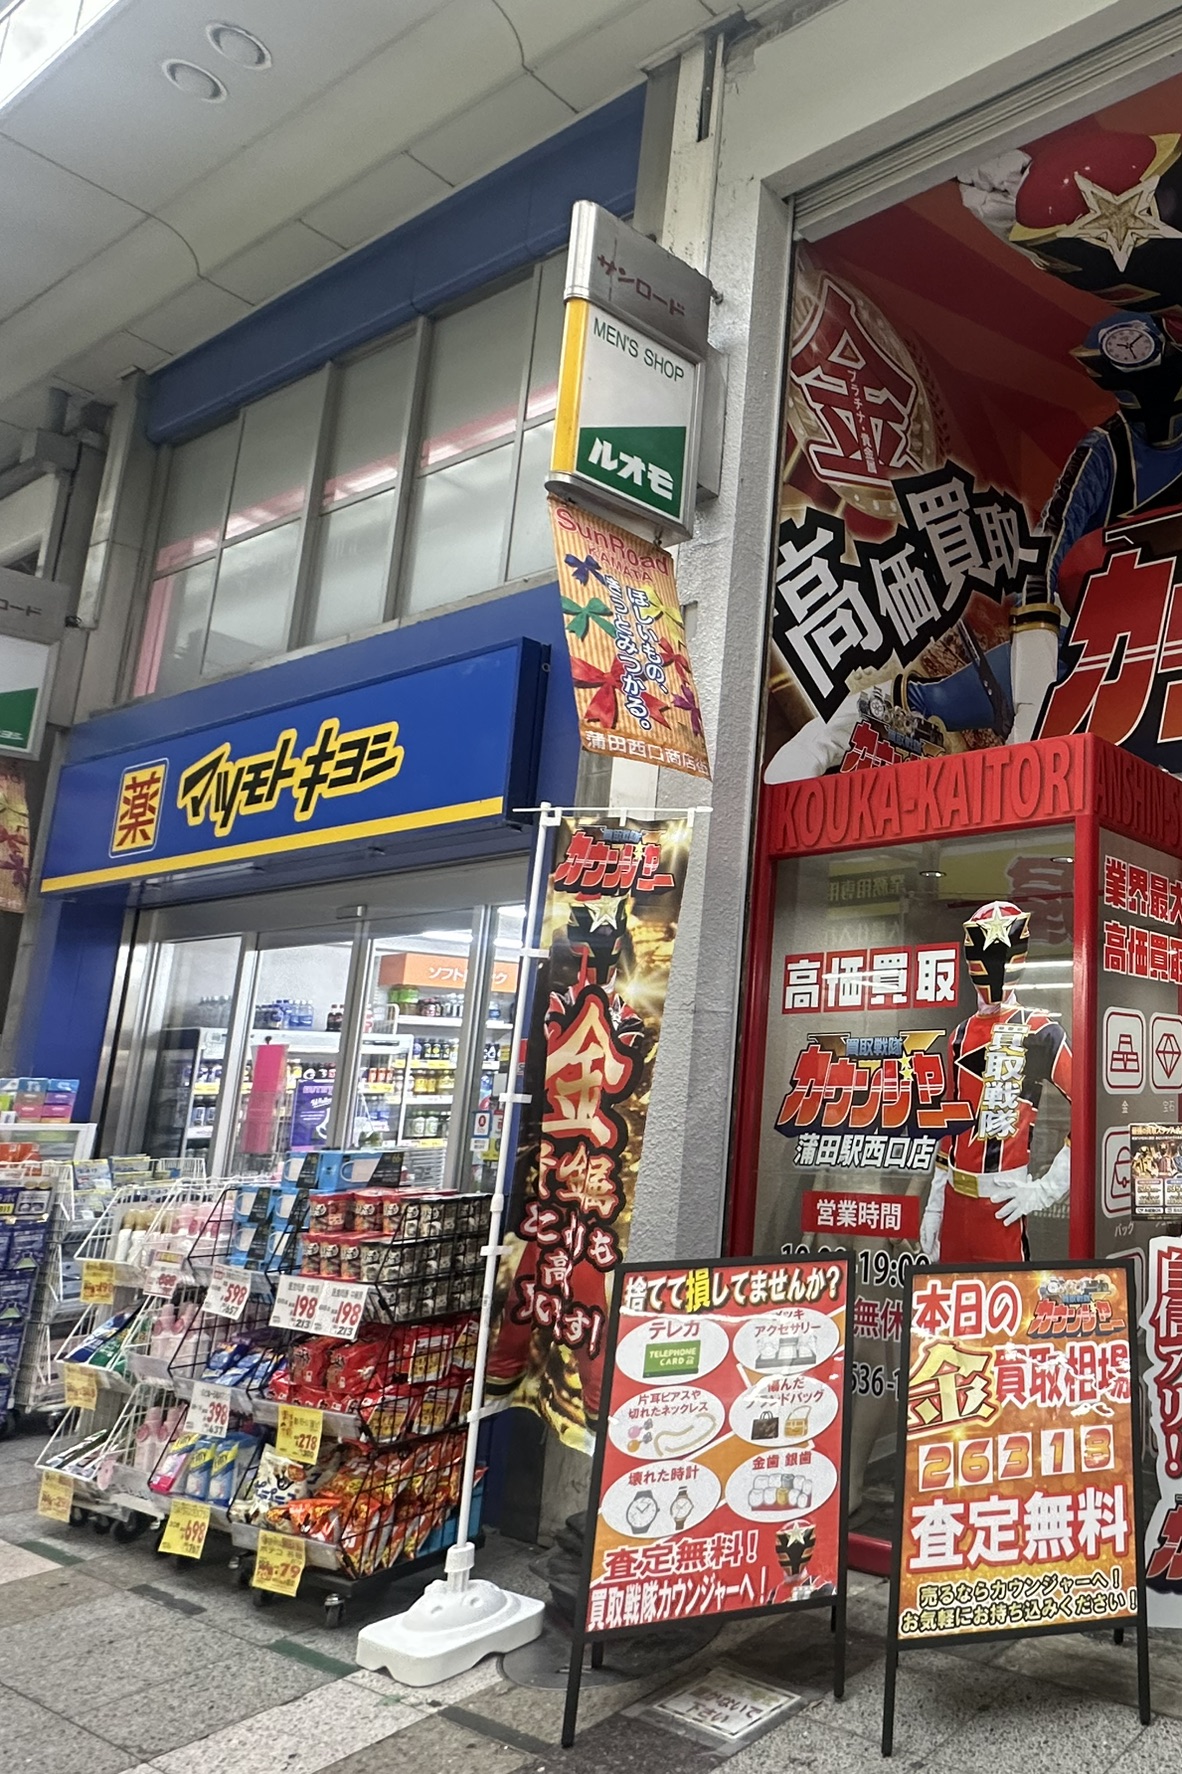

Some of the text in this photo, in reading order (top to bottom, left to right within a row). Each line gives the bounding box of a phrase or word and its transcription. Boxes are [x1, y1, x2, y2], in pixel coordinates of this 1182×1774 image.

[597, 254, 686, 317] サンロード
[593, 317, 685, 383] MEN'S SHOP
[587, 436, 674, 501] ルオモ
[556, 507, 670, 577] SunRoad
[588, 546, 654, 583] KAMATA
[773, 474, 1040, 700] 高価買取
[604, 574, 652, 731] きっとみつかる。
[626, 585, 669, 695] ほしいもの、
[178, 717, 406, 836] マツモトキヨシ
[774, 739, 1086, 851] KOUKA-KAITORI
[118, 773, 163, 848] 薬
[554, 831, 675, 892] カウンジャー
[785, 949, 957, 1010] 高価買取
[845, 1036, 903, 1057] 買取戦隊
[776, 1044, 974, 1129] カウンジャー
[978, 1023, 1031, 1139] 買取戦隊
[794, 1133, 937, 1170] 蒲田駅西口店
[816, 1198, 902, 1231] 営業時間
[224, 1283, 248, 1306] 598
[293, 1295, 318, 1319] 198
[915, 1280, 1021, 1338] 本日の
[335, 1301, 362, 1326] 198
[649, 1321, 699, 1338] テレカ
[755, 1322, 821, 1338] アクセサリー
[649, 1347, 697, 1358] TELEPHONE
[660, 1357, 685, 1366] CARD
[207, 1402, 229, 1425] 398
[628, 1401, 709, 1420] 切れたネックレス
[637, 1390, 701, 1405] 片耳ピアスや
[298, 1433, 318, 1451] 278
[752, 1451, 812, 1470] 金歯 銀歯
[628, 1465, 700, 1486] 壊れた時計
[184, 1520, 206, 1544] 698
[909, 1484, 1130, 1571] 査定無料
[280, 1563, 301, 1579] 79
[603, 1530, 759, 1583] 査定無料!
